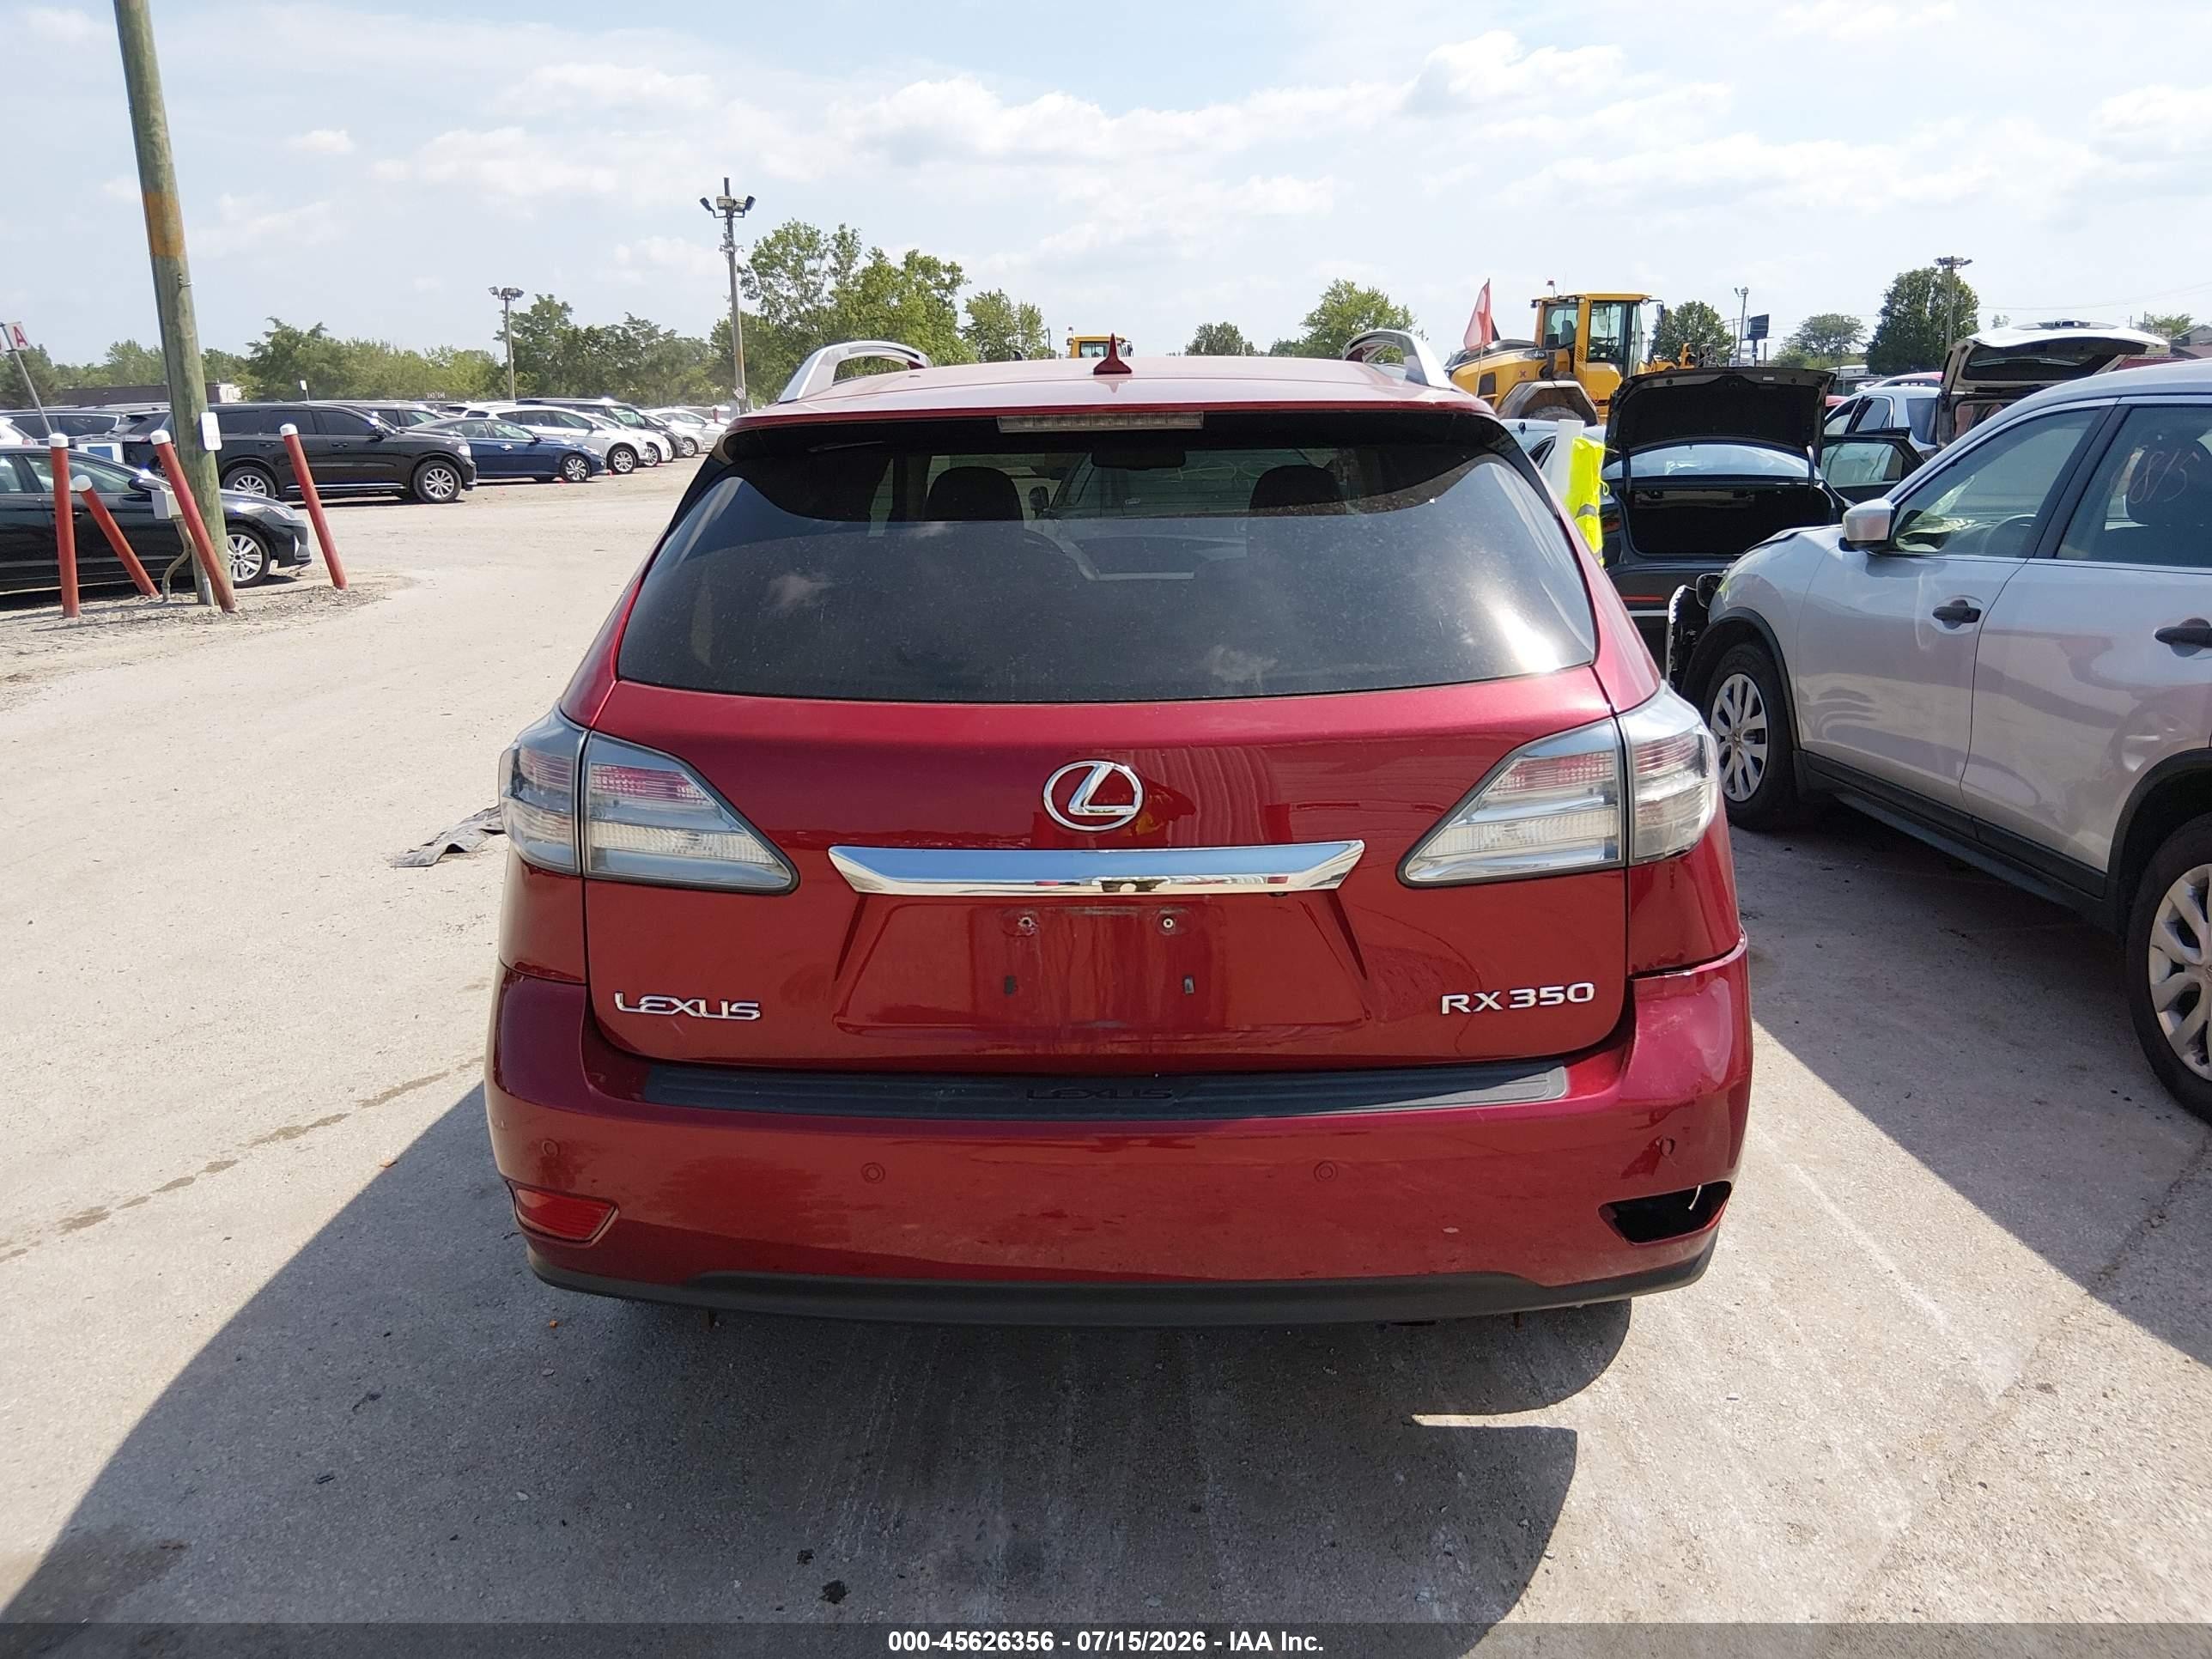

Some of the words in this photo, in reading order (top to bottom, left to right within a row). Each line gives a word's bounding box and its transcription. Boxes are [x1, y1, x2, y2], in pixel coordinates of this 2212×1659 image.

[13, 325, 28, 348] A
[614, 992, 761, 1021] LEXUS
[1026, 1087, 1173, 1100] LEXUS
